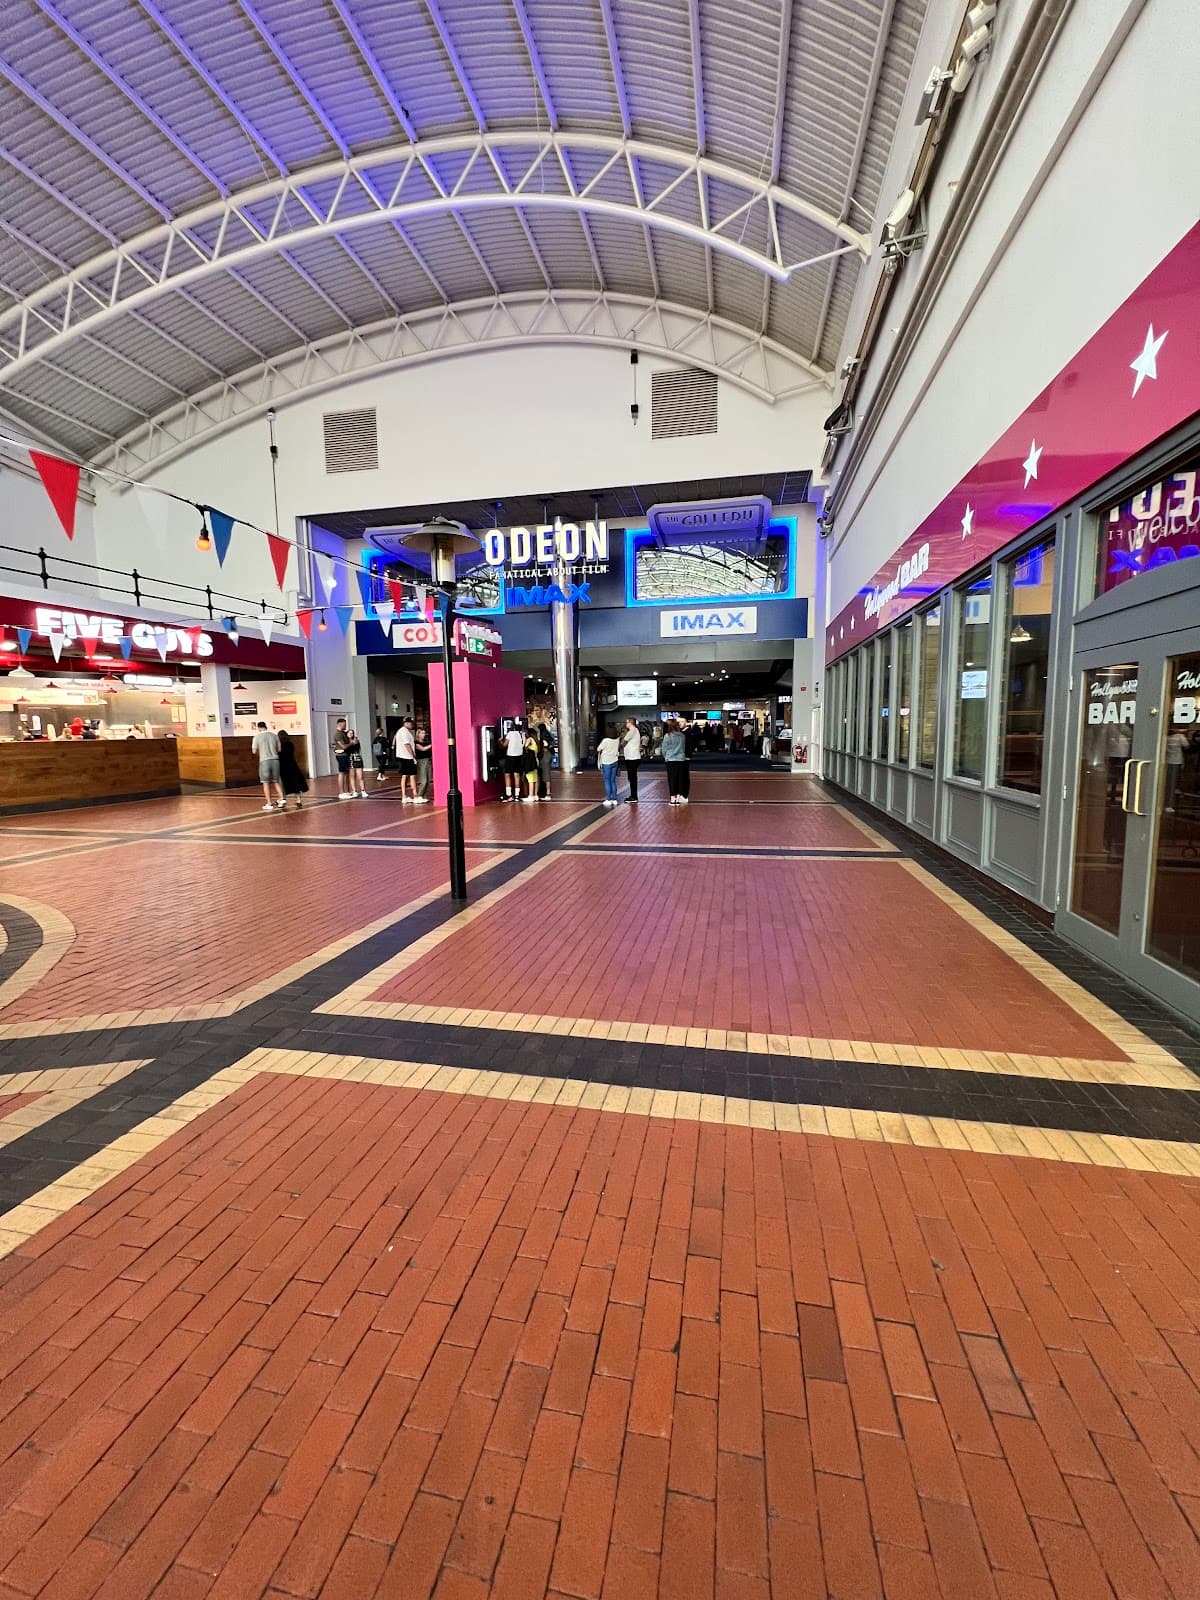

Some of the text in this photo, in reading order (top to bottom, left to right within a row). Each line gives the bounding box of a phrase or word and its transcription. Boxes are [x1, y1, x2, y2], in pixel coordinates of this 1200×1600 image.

[485, 521, 608, 566] ODEON
[489, 565, 608, 580] FANATICAL ABOUT FILM
[900, 542, 930, 589] BAR
[506, 583, 592, 607] IMAX
[35, 607, 214, 657] FIVE GUYS
[673, 612, 745, 631] IMAX
[1088, 700, 1137, 725] BAR
[1173, 696, 1200, 724] B
